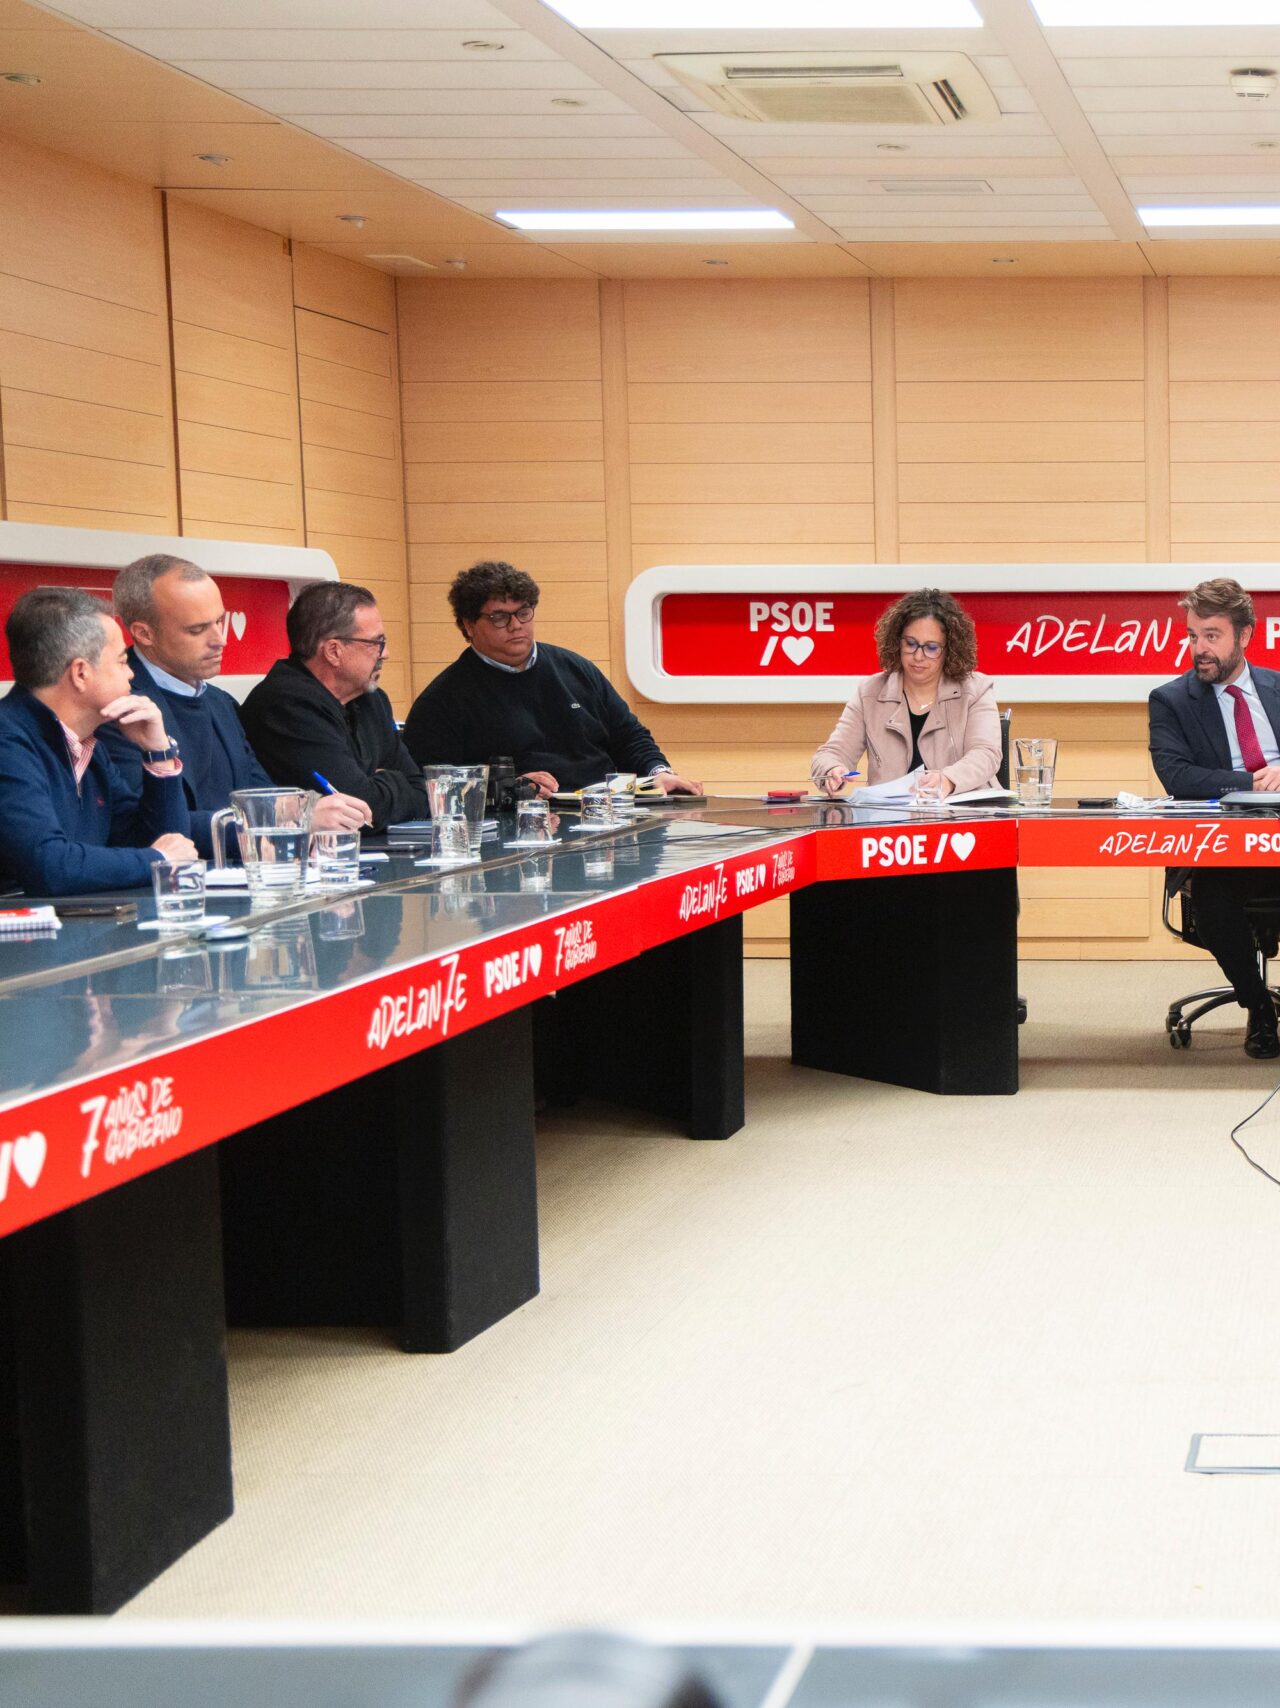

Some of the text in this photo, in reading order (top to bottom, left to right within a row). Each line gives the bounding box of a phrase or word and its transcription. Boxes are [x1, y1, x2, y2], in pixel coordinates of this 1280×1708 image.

[750, 601, 835, 632] PSOE
[862, 835, 928, 868] PSOE
[484, 951, 520, 998] PSOE
[554, 926, 566, 977] 7
[80, 1095, 107, 1179] 7
[150, 1076, 175, 1118] DE
[104, 1106, 183, 1166] GOBIERNO
